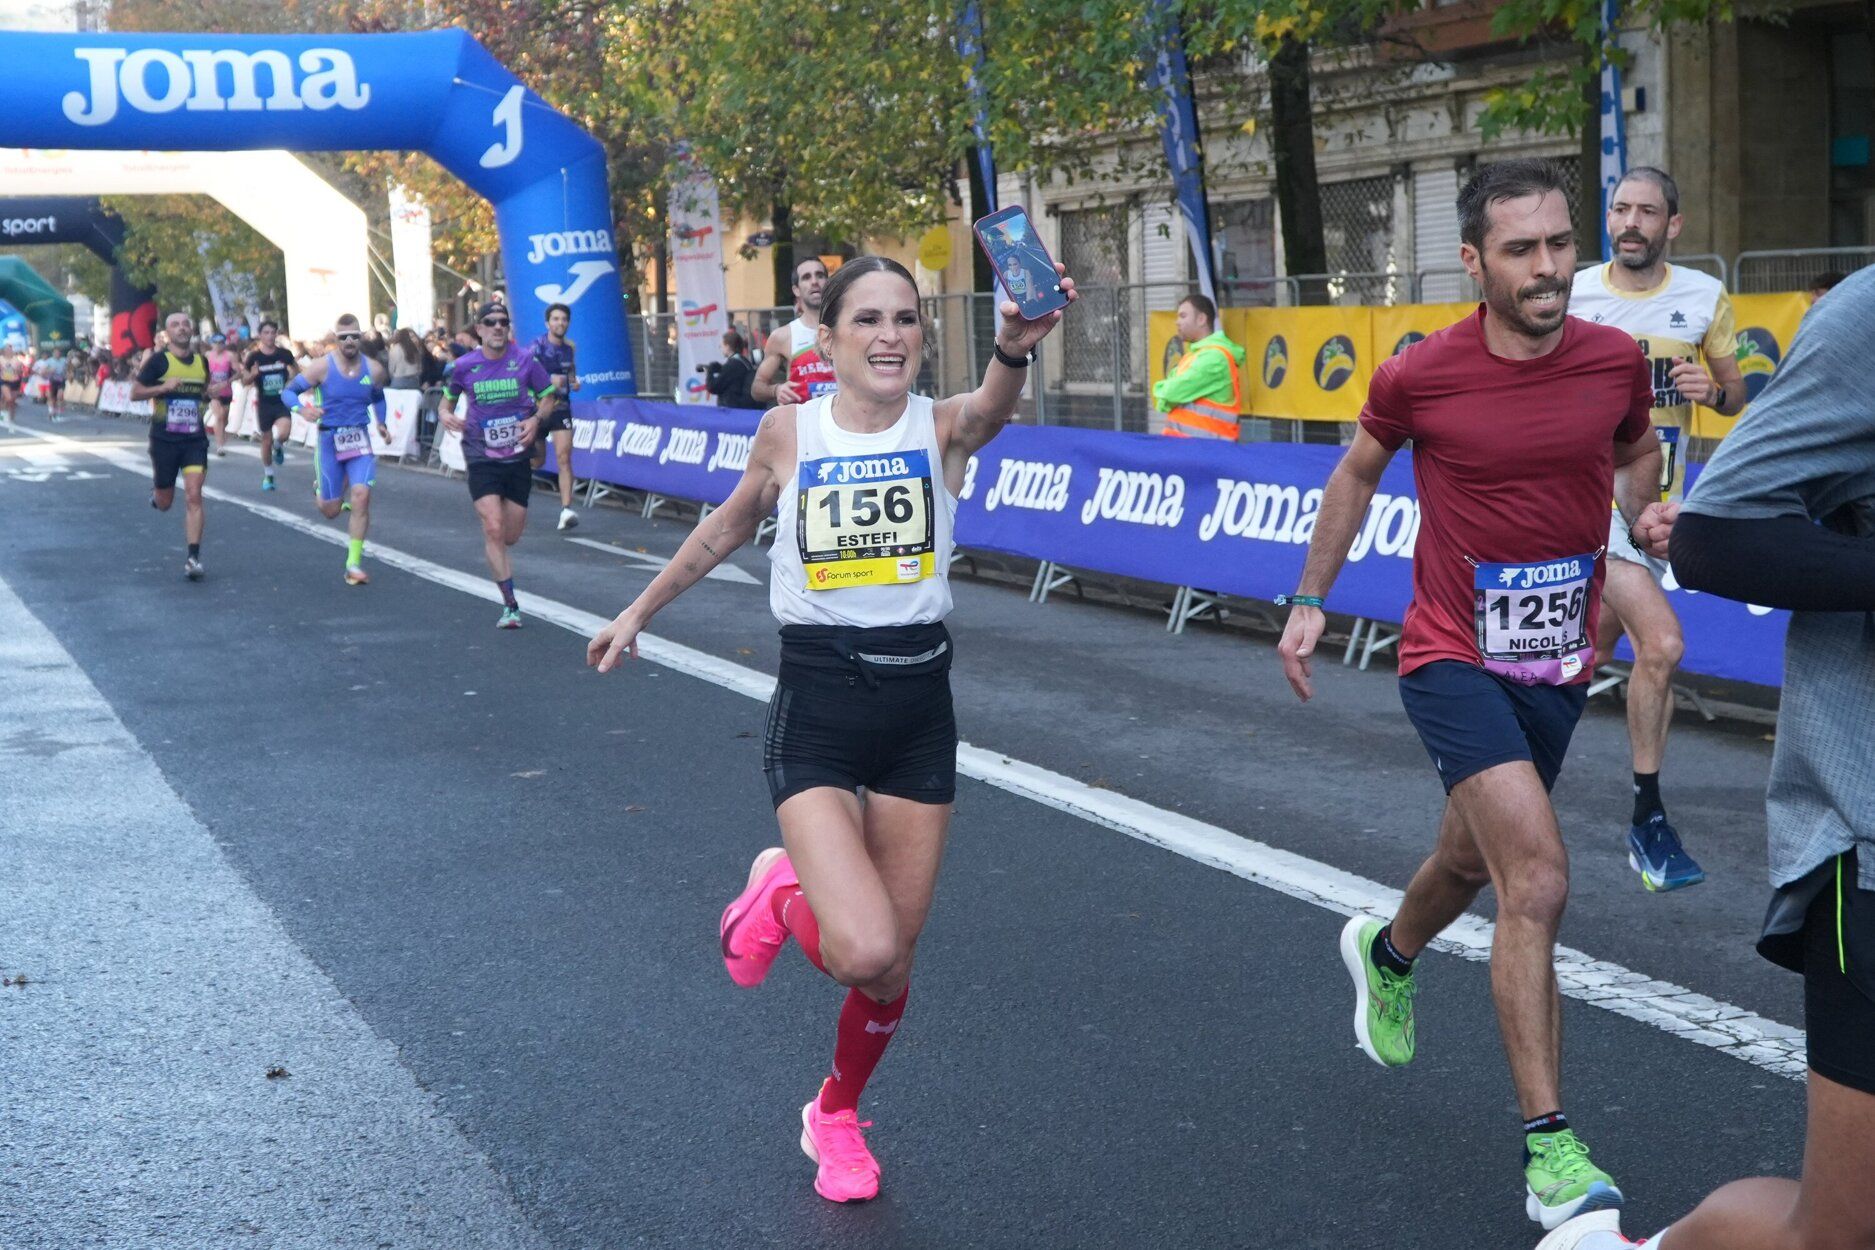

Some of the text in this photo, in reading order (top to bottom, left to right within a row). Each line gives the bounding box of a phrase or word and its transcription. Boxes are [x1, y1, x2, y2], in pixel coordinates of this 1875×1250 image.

[62, 47, 371, 126] Joma
[2, 215, 57, 236] sport
[527, 229, 613, 264] Joma
[338, 433, 361, 445] 920
[490, 425, 517, 441] 857
[616, 422, 663, 457] Joma
[659, 427, 708, 465] Joma
[836, 457, 910, 483] Joma
[819, 485, 914, 528] 156
[985, 458, 1073, 512] Joma
[1080, 467, 1185, 528] Joma
[837, 531, 898, 547] ESTEFI
[1520, 560, 1581, 588] Joma
[1490, 586, 1584, 631] 1256
[1509, 631, 1568, 650] NICOLS
[874, 656, 909, 664] ULTIMATE
